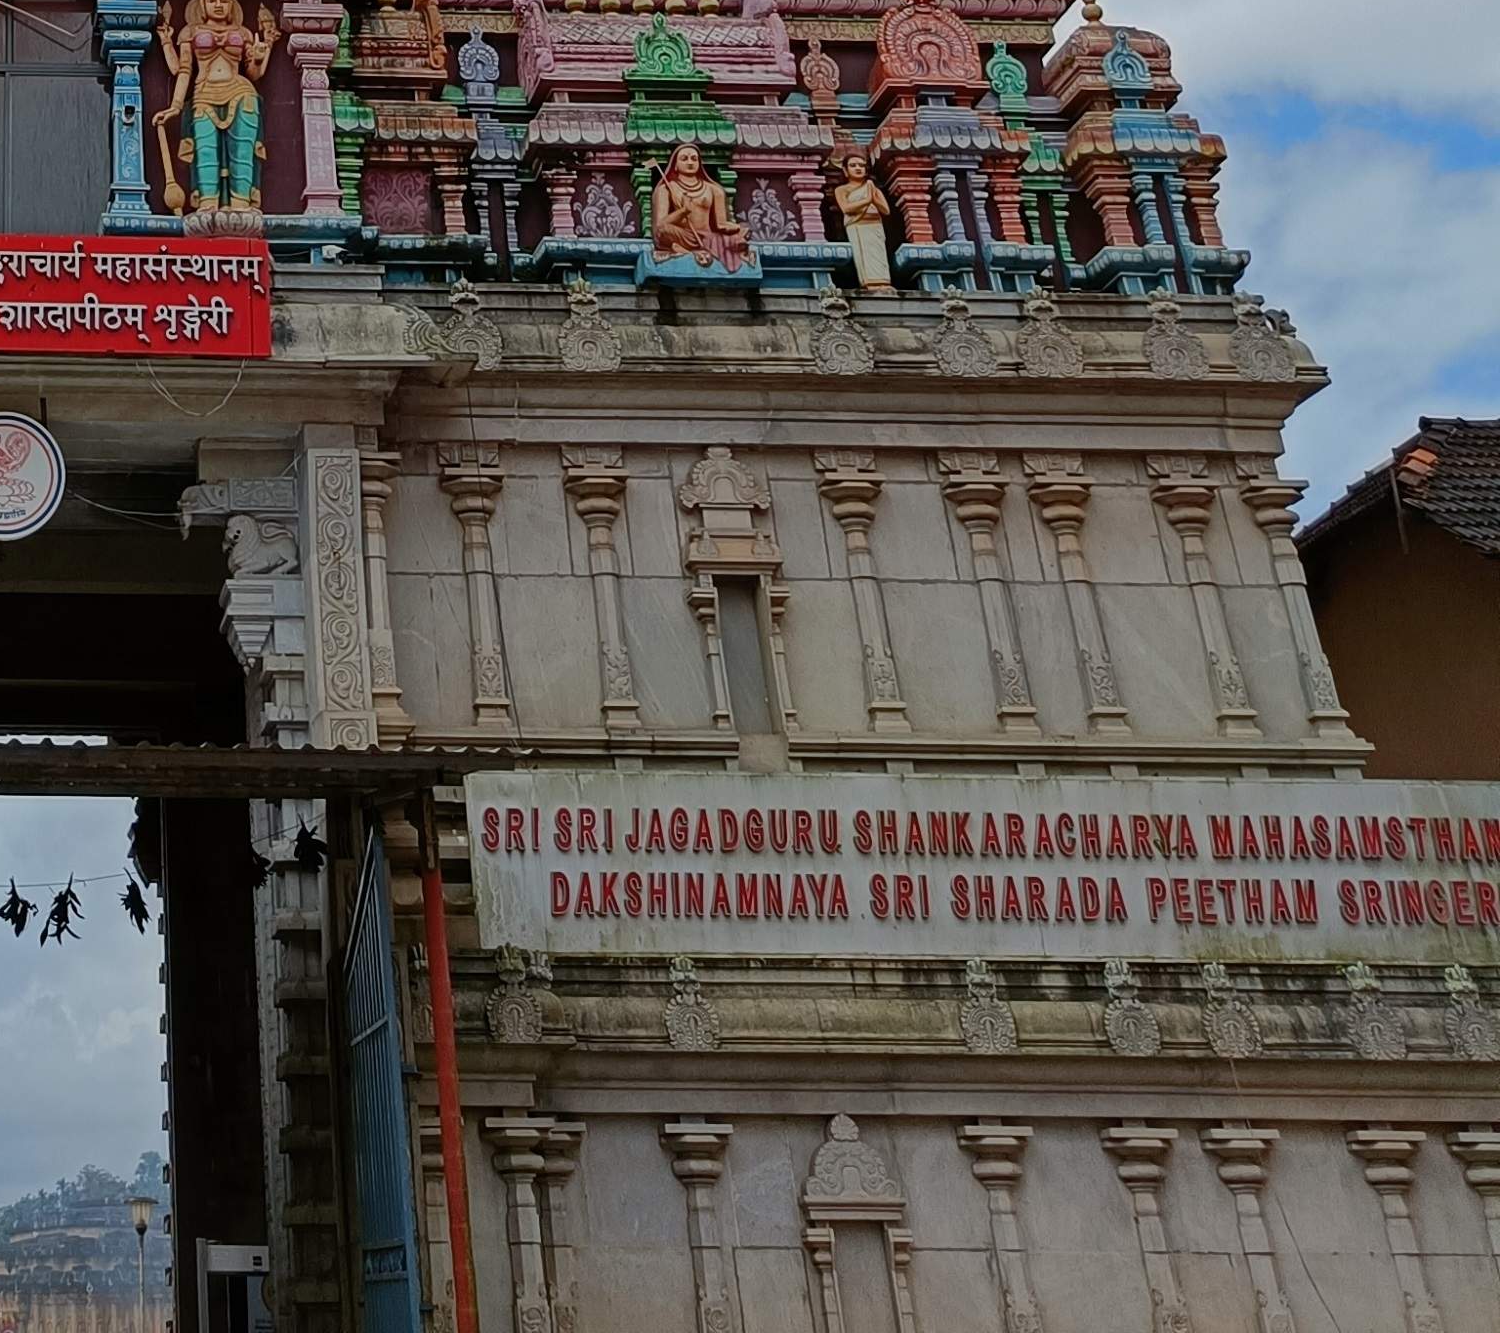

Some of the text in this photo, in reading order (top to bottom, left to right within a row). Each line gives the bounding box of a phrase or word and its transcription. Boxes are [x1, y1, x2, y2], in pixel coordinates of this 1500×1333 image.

[90, 244, 265, 294] महासंस्थानम्
[483, 808, 540, 852] SRI
[554, 808, 613, 853] SRI
[625, 807, 841, 855] JAGADGURU
[853, 810, 1198, 858] SHANKARACHARYA
[550, 871, 1500, 926] DAKSHINAMNAYA SRI SHARADA PEETHAM SRINGER
